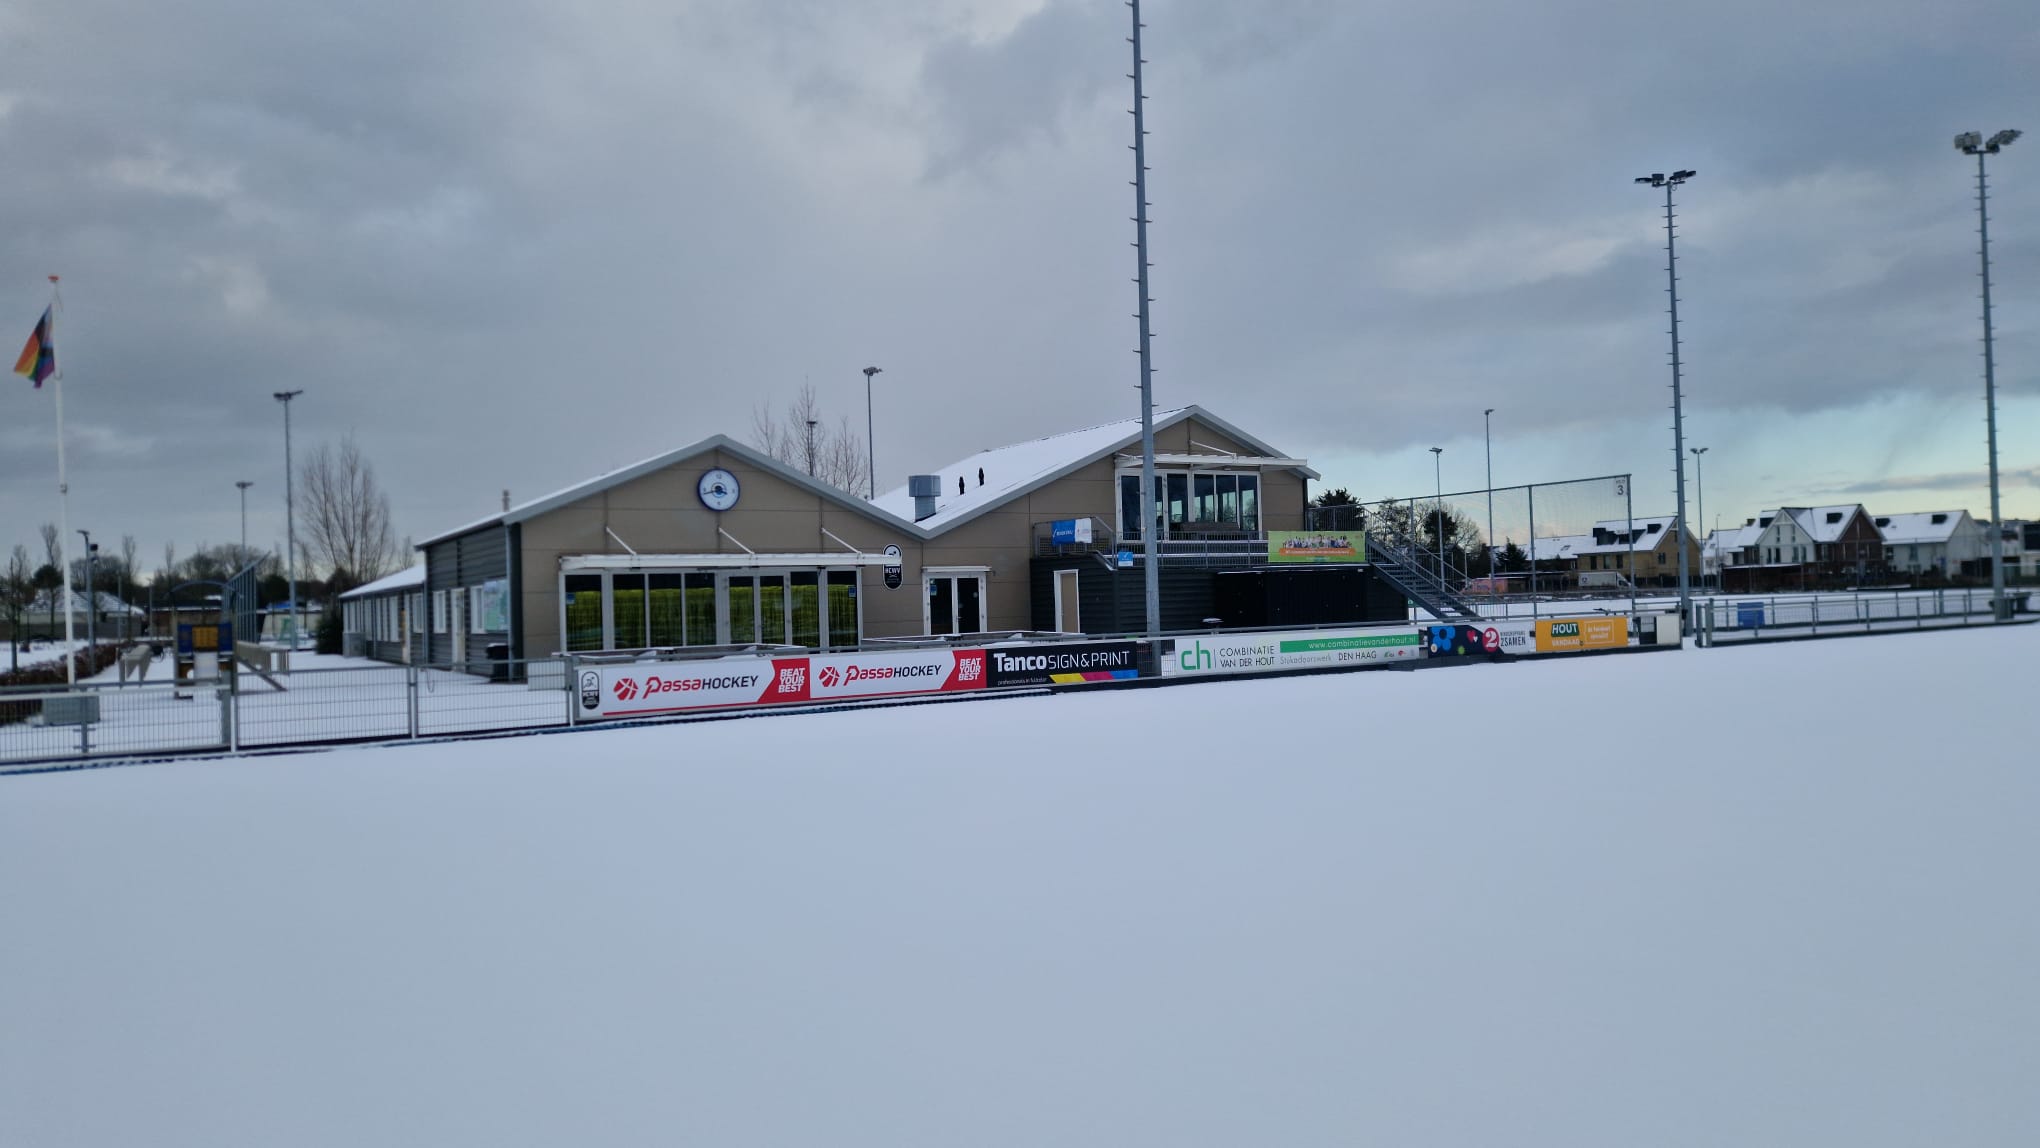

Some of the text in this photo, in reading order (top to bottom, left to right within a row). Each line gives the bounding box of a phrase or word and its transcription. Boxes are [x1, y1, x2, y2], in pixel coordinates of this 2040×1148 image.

[1617, 485, 1624, 495] 3
[1551, 623, 1578, 635] HOUT
[1485, 630, 1497, 648] 2
[1219, 645, 1275, 658] COMBINATIE
[1338, 652, 1354, 661] DEN
[1355, 650, 1377, 660] HAAG
[960, 657, 982, 667] BEAT
[1220, 656, 1275, 668] VAN DER HOUT
[780, 667, 806, 677] BEAT
[960, 665, 981, 675] YOUR
[780, 675, 805, 686] YOUR
[958, 672, 980, 681] BEST
[778, 683, 801, 694] BEST
